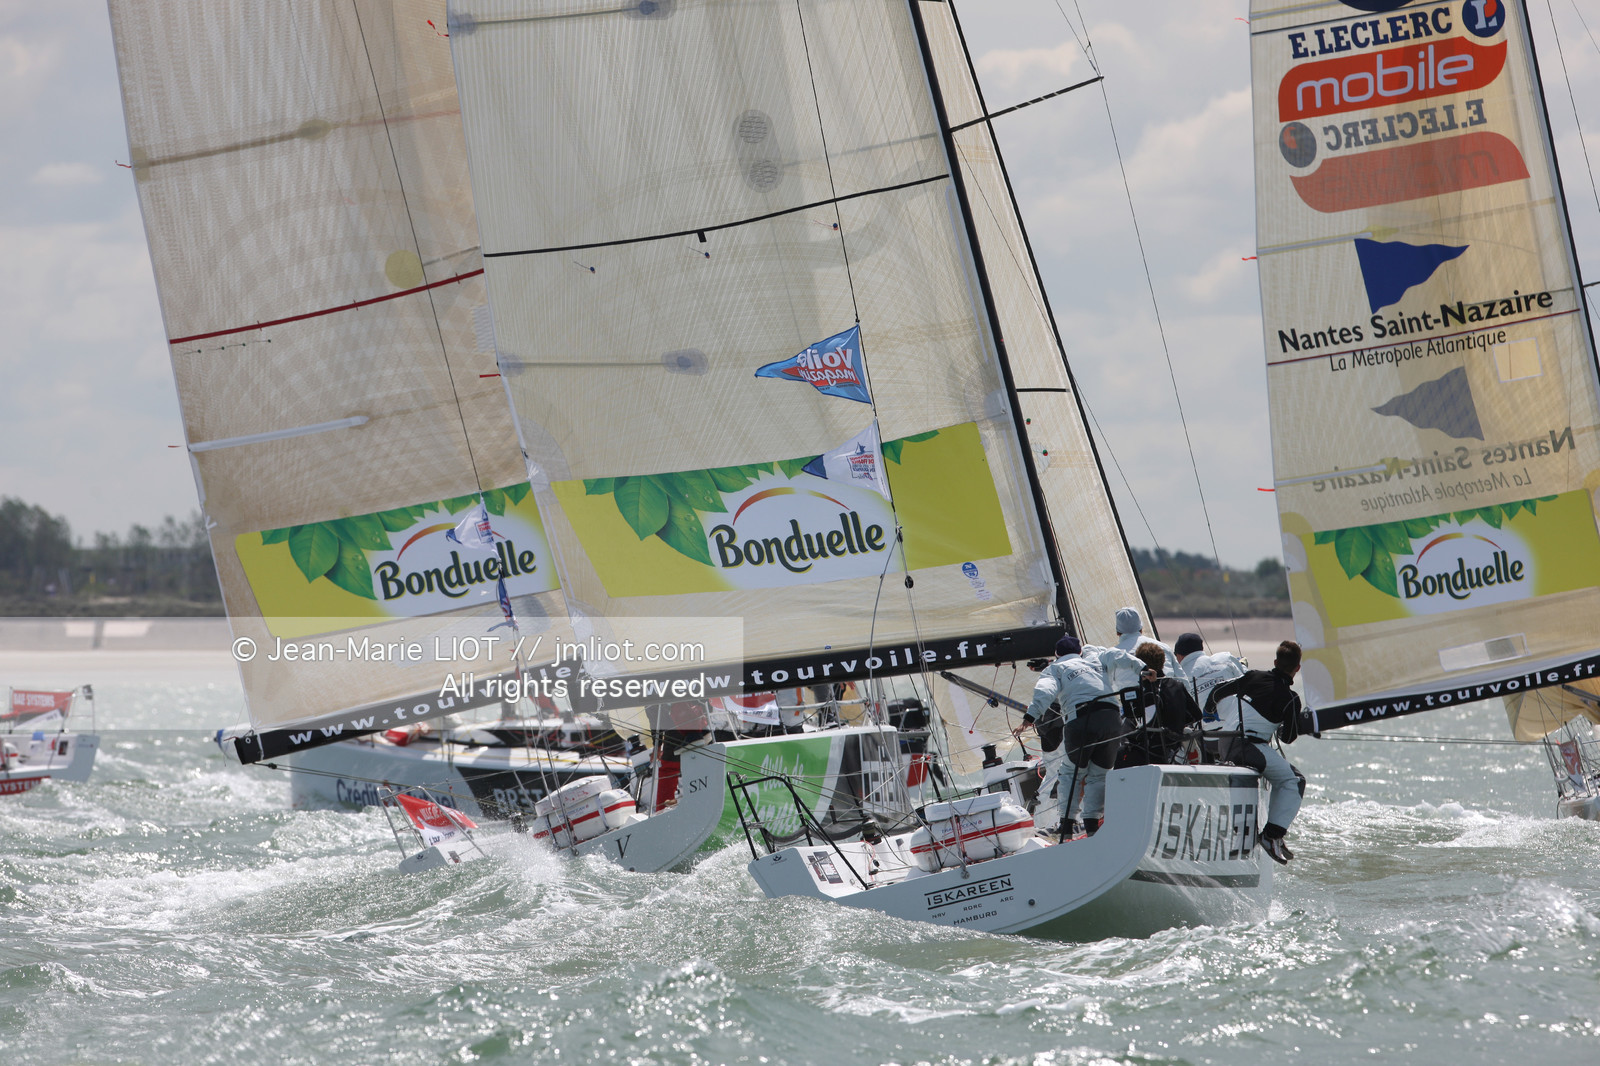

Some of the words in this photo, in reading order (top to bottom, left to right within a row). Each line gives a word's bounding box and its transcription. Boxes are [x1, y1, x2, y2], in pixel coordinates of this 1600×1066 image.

[1288, 7, 1452, 59] E.LECLERC
[1296, 44, 1475, 111] mobile
[1278, 320, 1364, 353] Nantes
[1370, 290, 1553, 339] Saint-Nazaire
[1329, 354, 1347, 372] La
[1352, 342, 1423, 369] Métropole
[1426, 328, 1507, 357] Atlantique
[708, 510, 886, 574] Bonduelle
[373, 539, 537, 600] Bonduelle
[1398, 550, 1525, 600] Bonduelle
[1346, 663, 1597, 720] www.tourvoile.fr
[689, 776, 708, 794] SN
[927, 878, 1012, 907] ISKAREEN
[953, 910, 998, 926] HAMBURG
[1000, 895, 1014, 903] ARC
